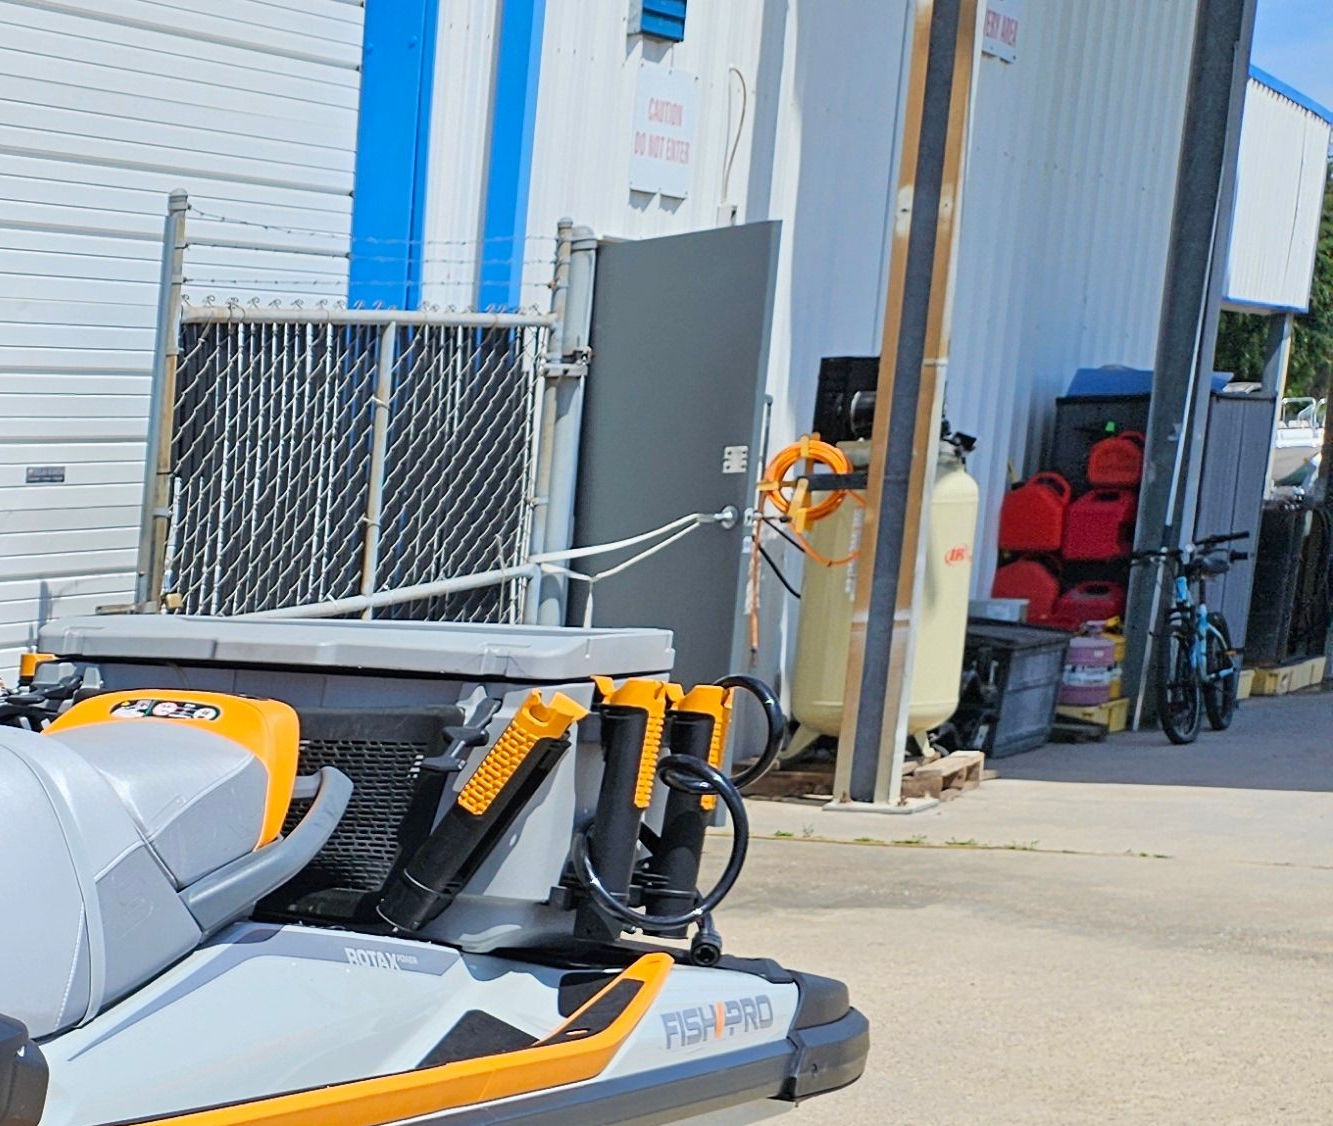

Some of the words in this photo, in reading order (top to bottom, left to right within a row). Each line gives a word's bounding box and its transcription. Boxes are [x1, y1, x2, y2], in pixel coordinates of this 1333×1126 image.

[648, 97, 683, 127] CAUTION
[634, 131, 646, 156] DO
[648, 133, 665, 158] NOT
[666, 137, 690, 164] ENTER
[344, 947, 401, 970] ROTAX
